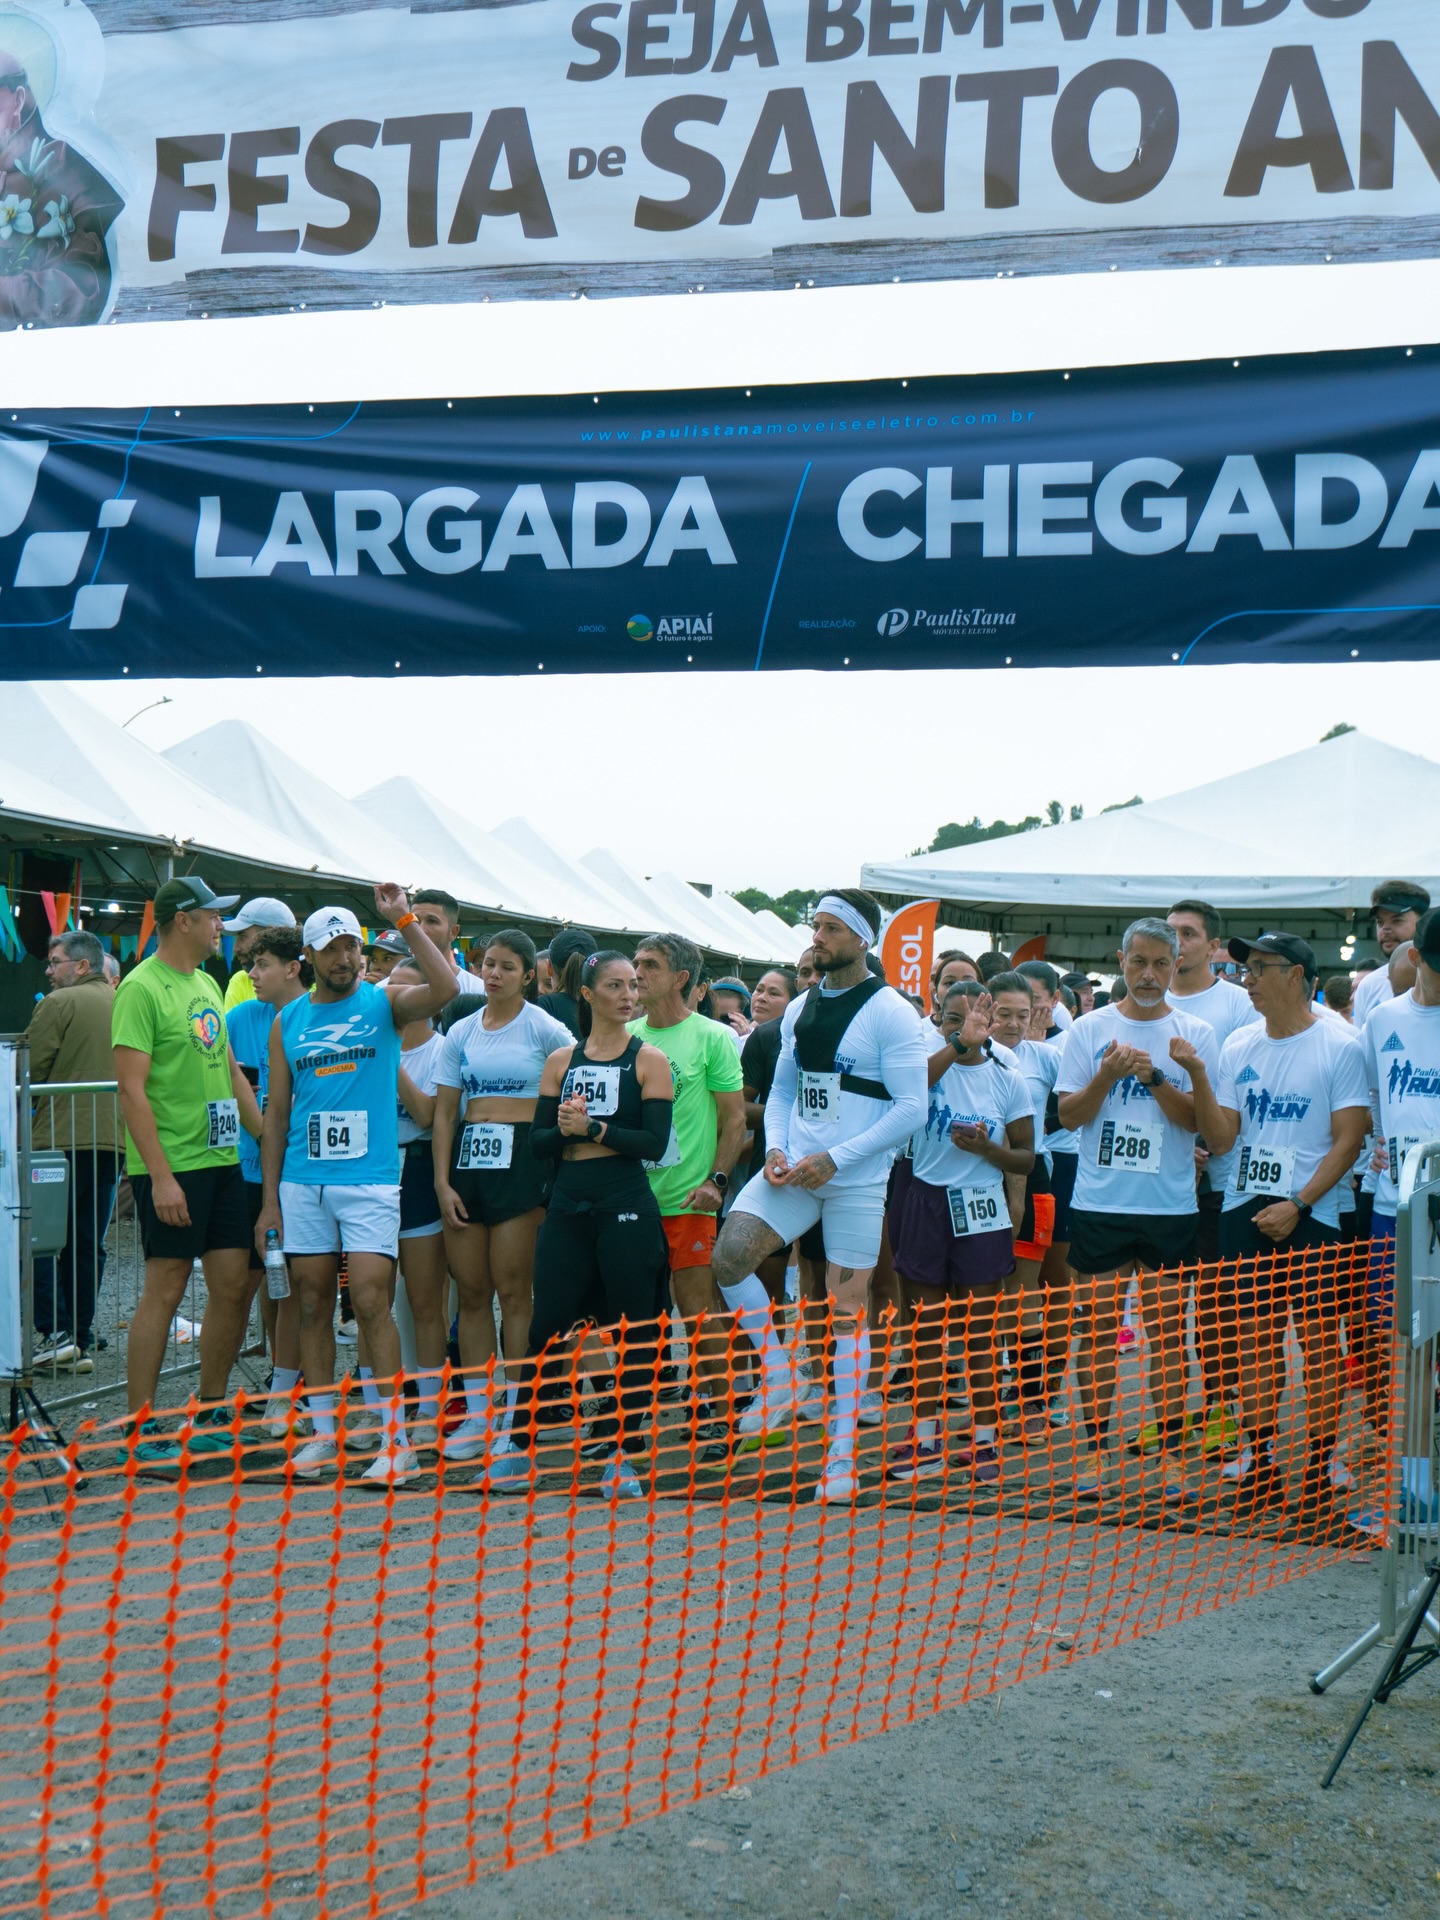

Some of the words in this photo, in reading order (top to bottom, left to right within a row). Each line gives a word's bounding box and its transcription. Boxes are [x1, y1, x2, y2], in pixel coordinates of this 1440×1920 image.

[565, 0, 780, 83] SEJA
[805, 0, 1371, 63] BEM-V
[147, 106, 559, 263] FESTA
[633, 58, 1180, 233] SANTO
[580, 409, 1035, 442] www.paulistanamoveiseeletro.com.br
[837, 448, 1440, 562] CHEGADA
[194, 475, 738, 579] LARGADA
[656, 612, 714, 635] APIAÍ
[799, 619, 857, 630] REALIZAÇÃO:
[912, 608, 1017, 628] PaulisTana
[577, 625, 607, 634] APOIO:
[656, 634, 664, 642] O
[664, 634, 687, 642] futuro
[687, 634, 692, 642] é
[692, 635, 713, 643] agora
[932, 627, 961, 636] MÓVEIS
[962, 627, 967, 635] E
[968, 627, 997, 635] ELETRO
[294, 1046, 376, 1072] Alternativa
[318, 1063, 354, 1076] ACADEMIA
[669, 1060, 681, 1077] RUA
[481, 1077, 528, 1086] PaulisTana
[574, 1081, 607, 1103] 254
[803, 1087, 829, 1110] 185
[1267, 1102, 1309, 1120] RUN
[219, 1113, 237, 1135] 248
[326, 1126, 351, 1148] 64
[471, 1137, 503, 1158] 339
[1113, 1135, 1151, 1160] 288
[1248, 1160, 1282, 1184] 389
[967, 1197, 998, 1221] 150
